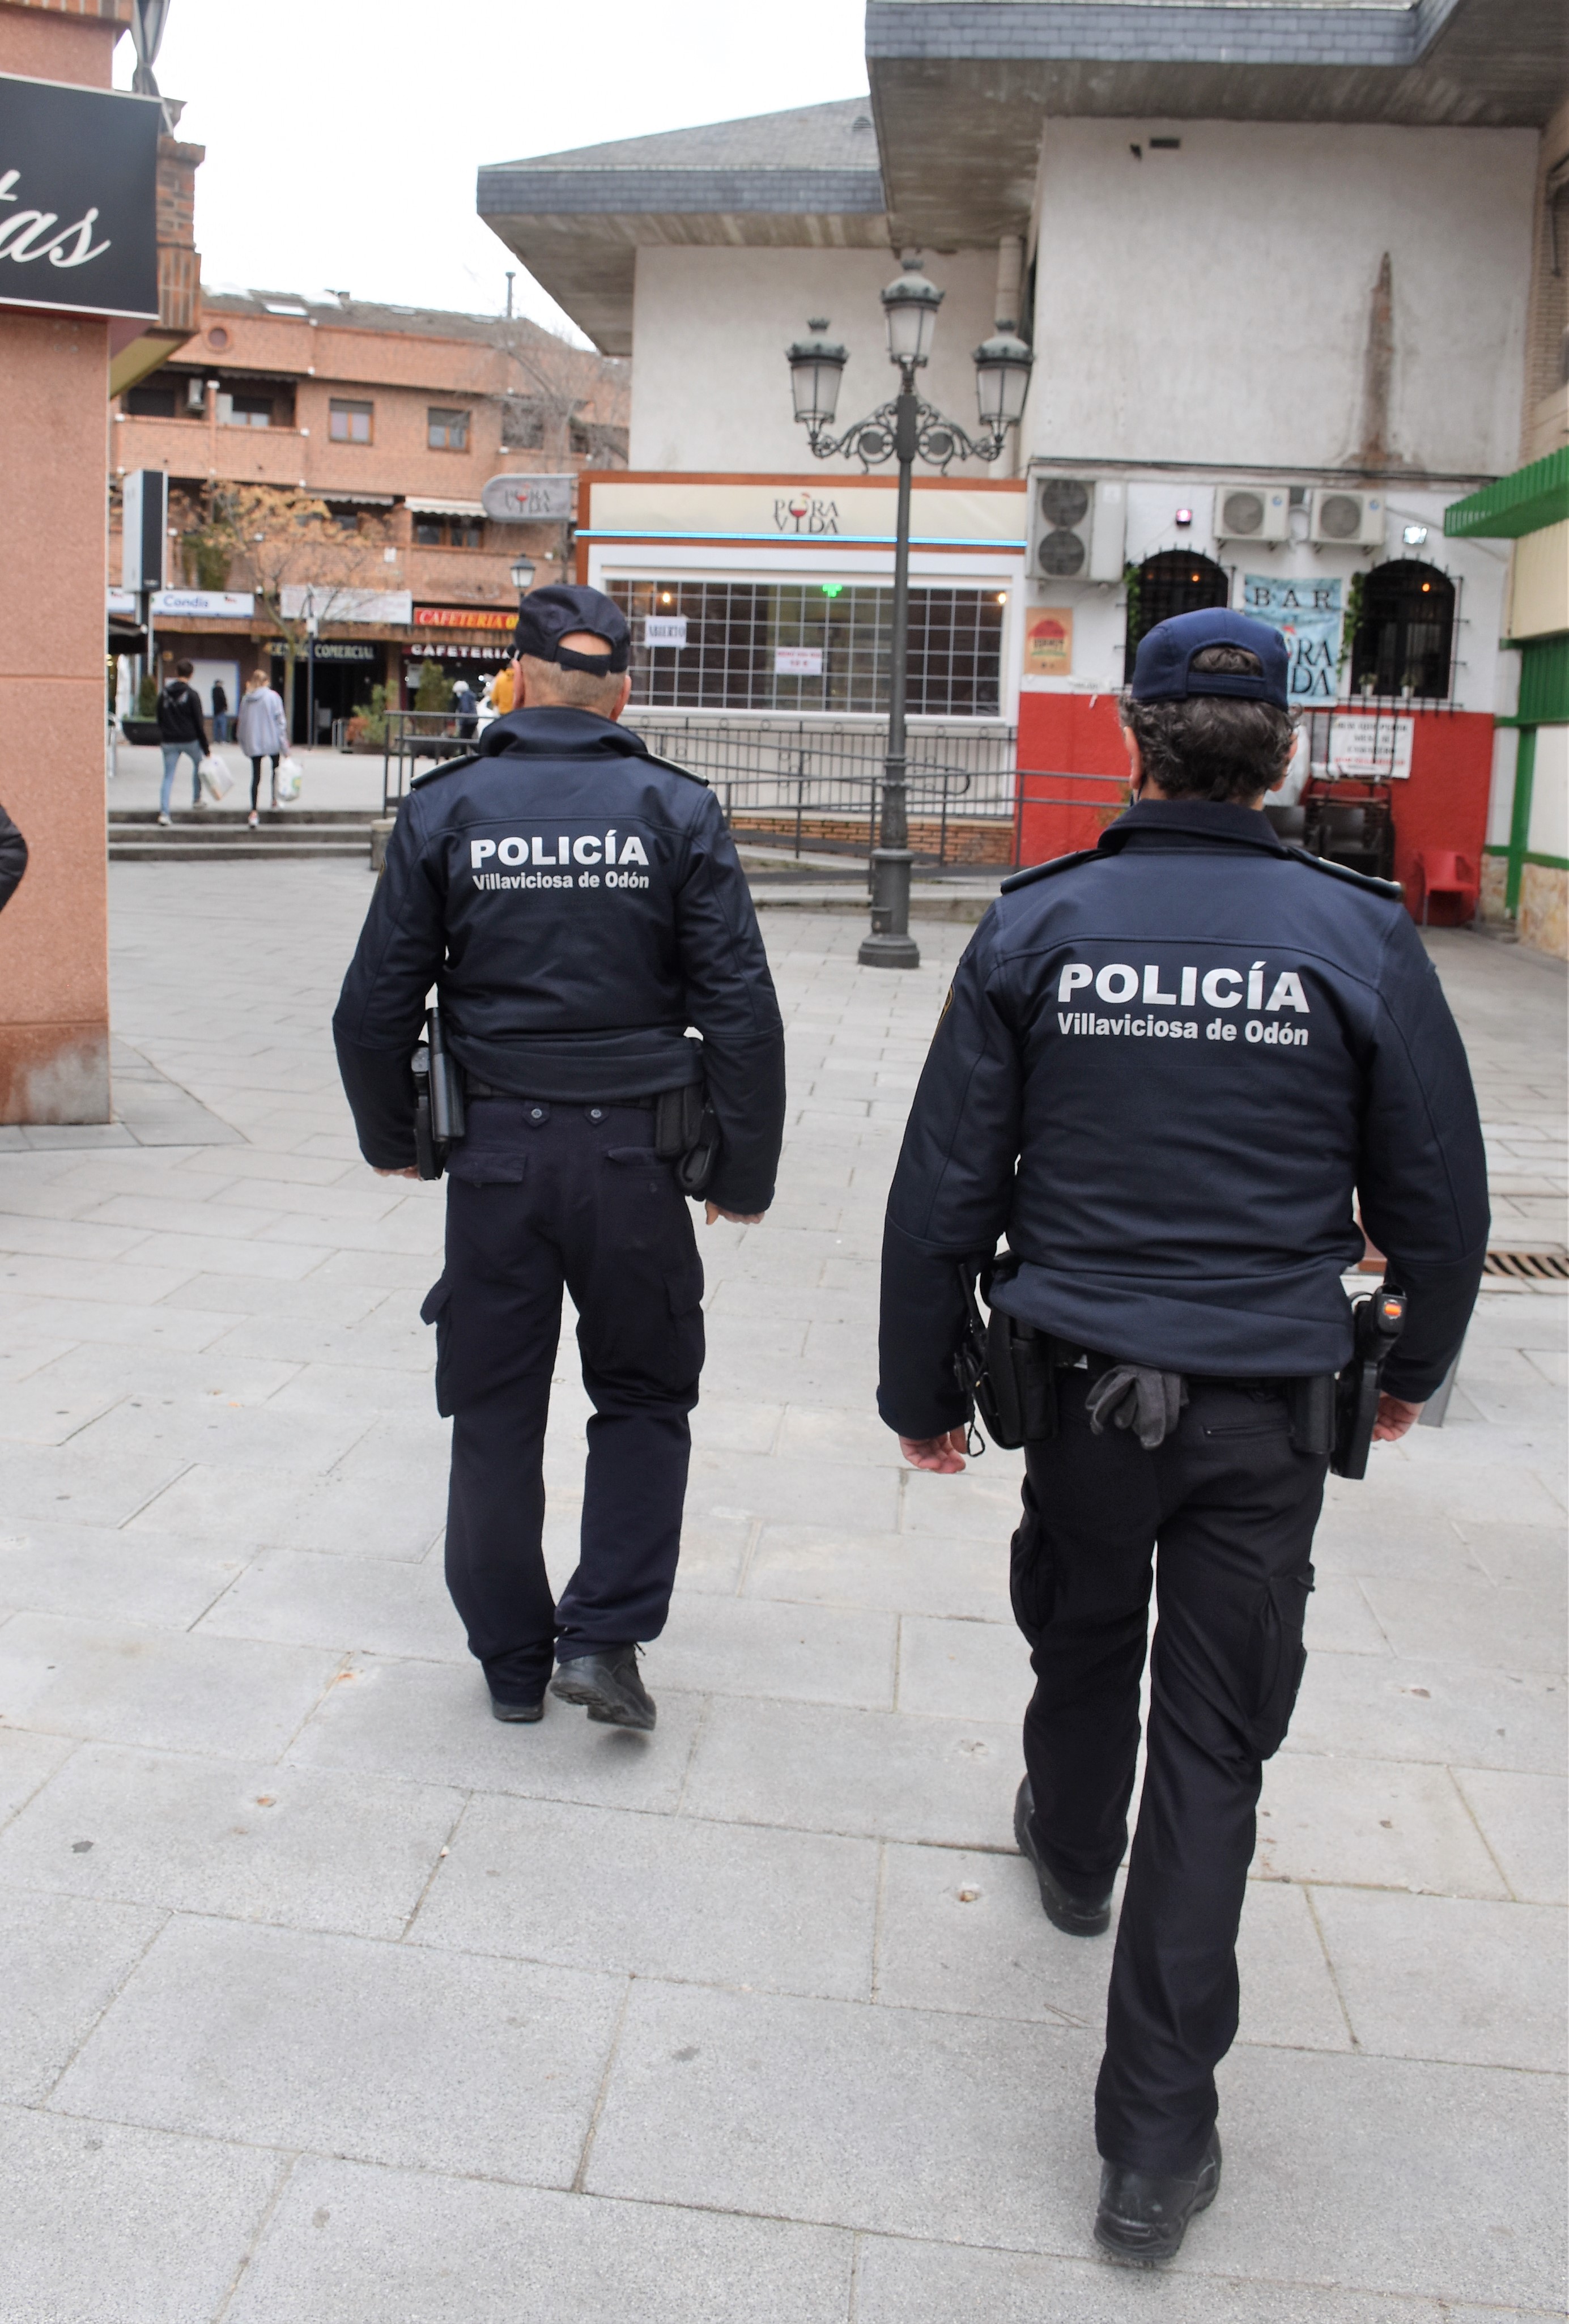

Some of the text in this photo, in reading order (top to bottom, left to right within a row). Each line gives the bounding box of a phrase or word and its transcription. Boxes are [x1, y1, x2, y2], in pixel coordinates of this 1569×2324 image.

[1254, 587, 1330, 609] BAR
[420, 610, 503, 628] CAFETERIA
[314, 644, 375, 659] COMERCIAL
[411, 643, 511, 659] CAFETERIA
[471, 829, 649, 869] POLICÍA
[472, 870, 649, 890] Villaviciosa de Odón
[1057, 961, 1311, 1013] POLICÍA
[1057, 1012, 1309, 1046] Villaviciosa de Odón
